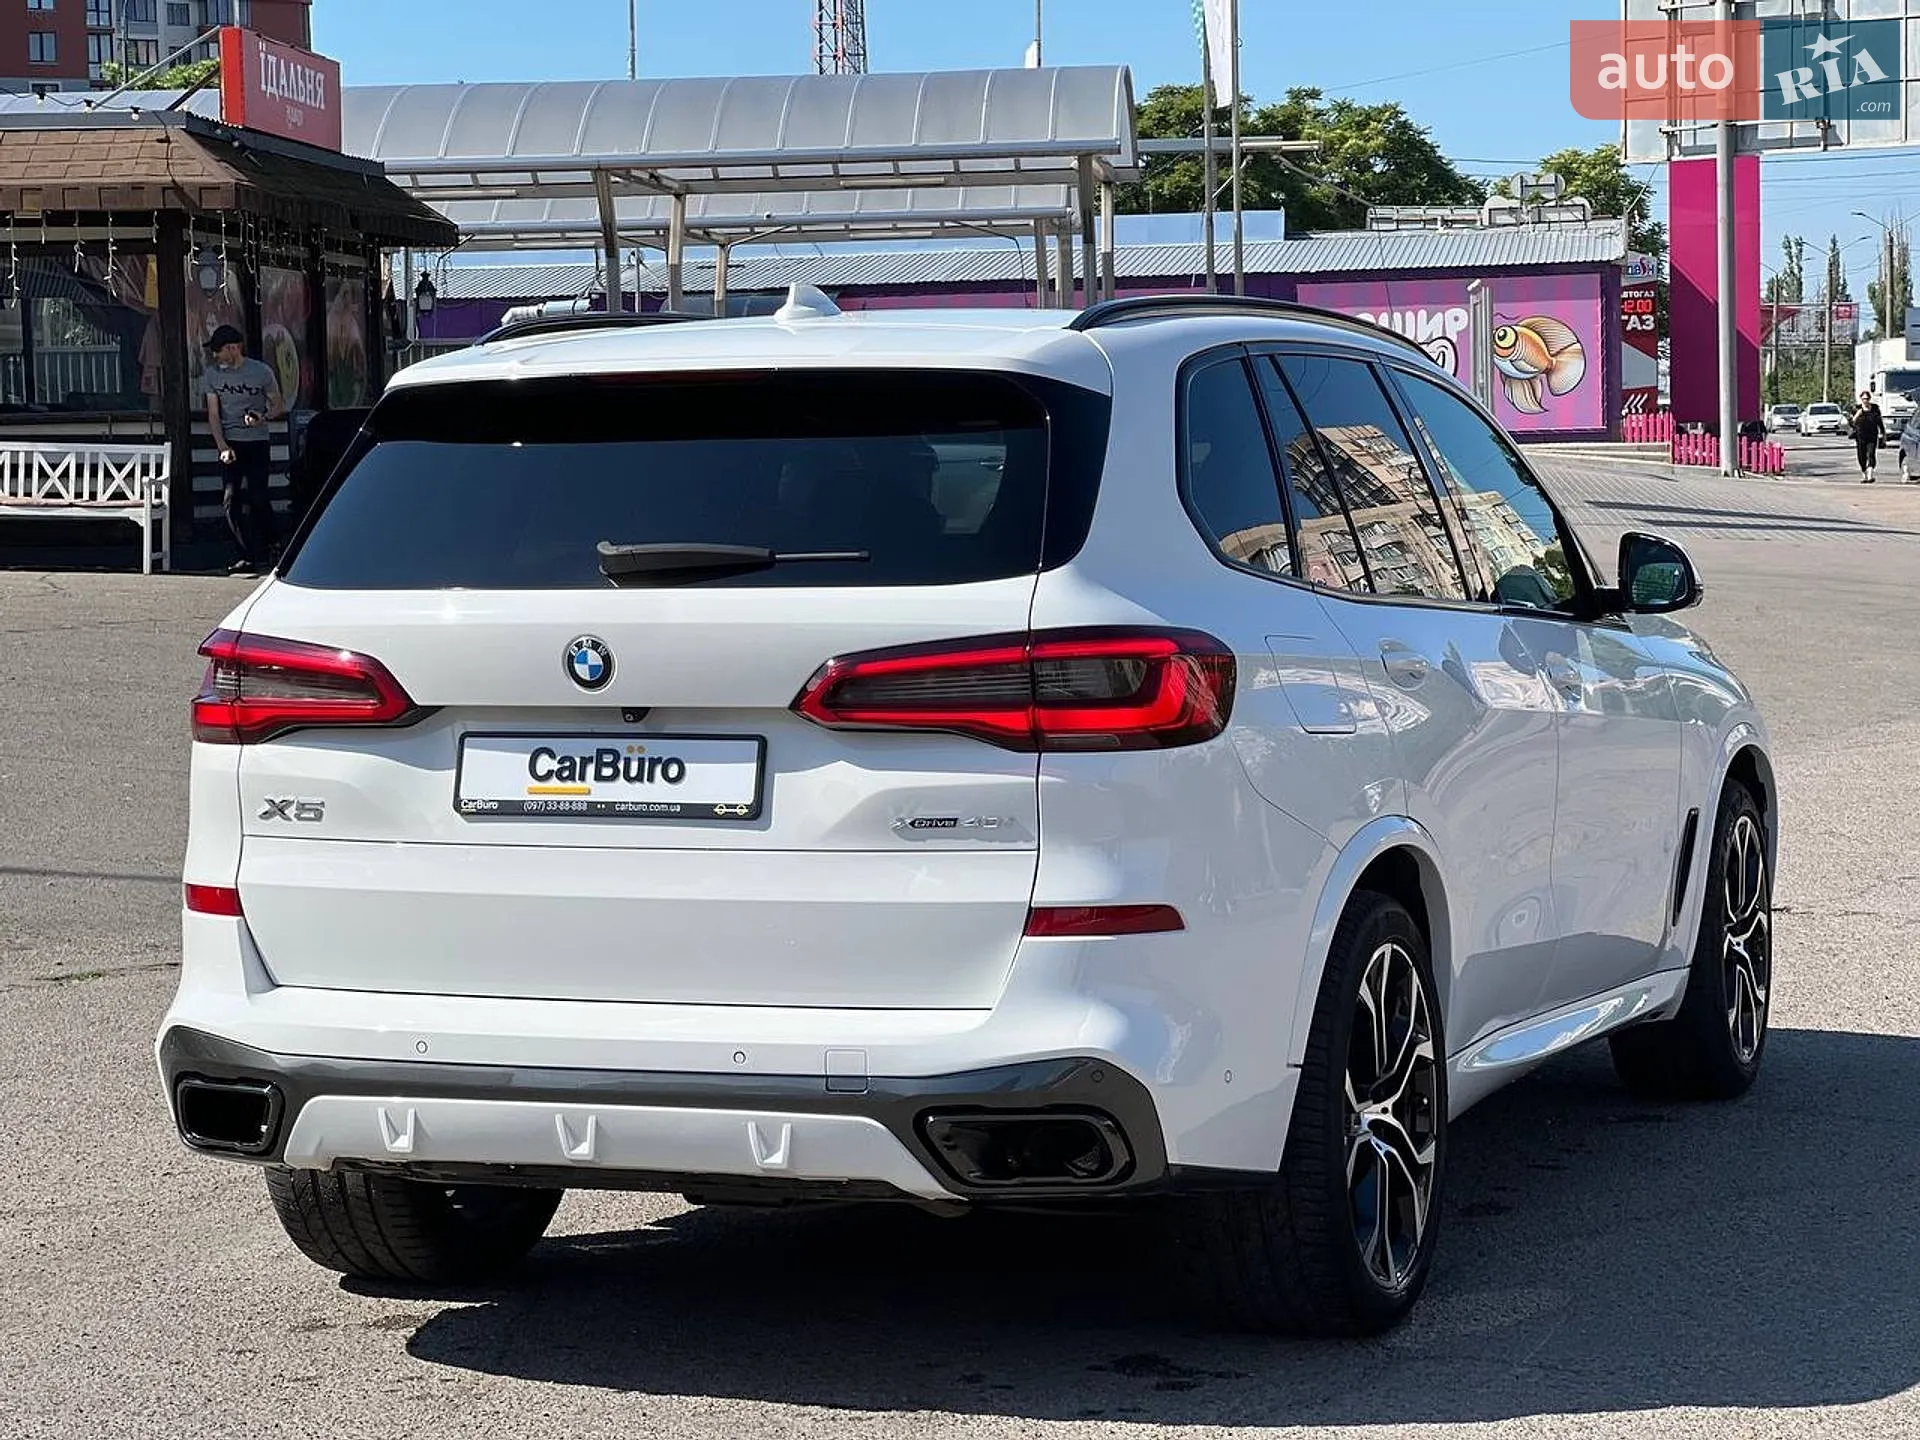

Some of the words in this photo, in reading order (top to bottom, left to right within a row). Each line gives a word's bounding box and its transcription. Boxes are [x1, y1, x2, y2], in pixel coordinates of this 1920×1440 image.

[258, 40, 325, 111] ЇДАЛЬНЯ
[569, 638, 609, 657] BMW
[528, 744, 687, 785] CarBüro
[258, 798, 325, 823] X5
